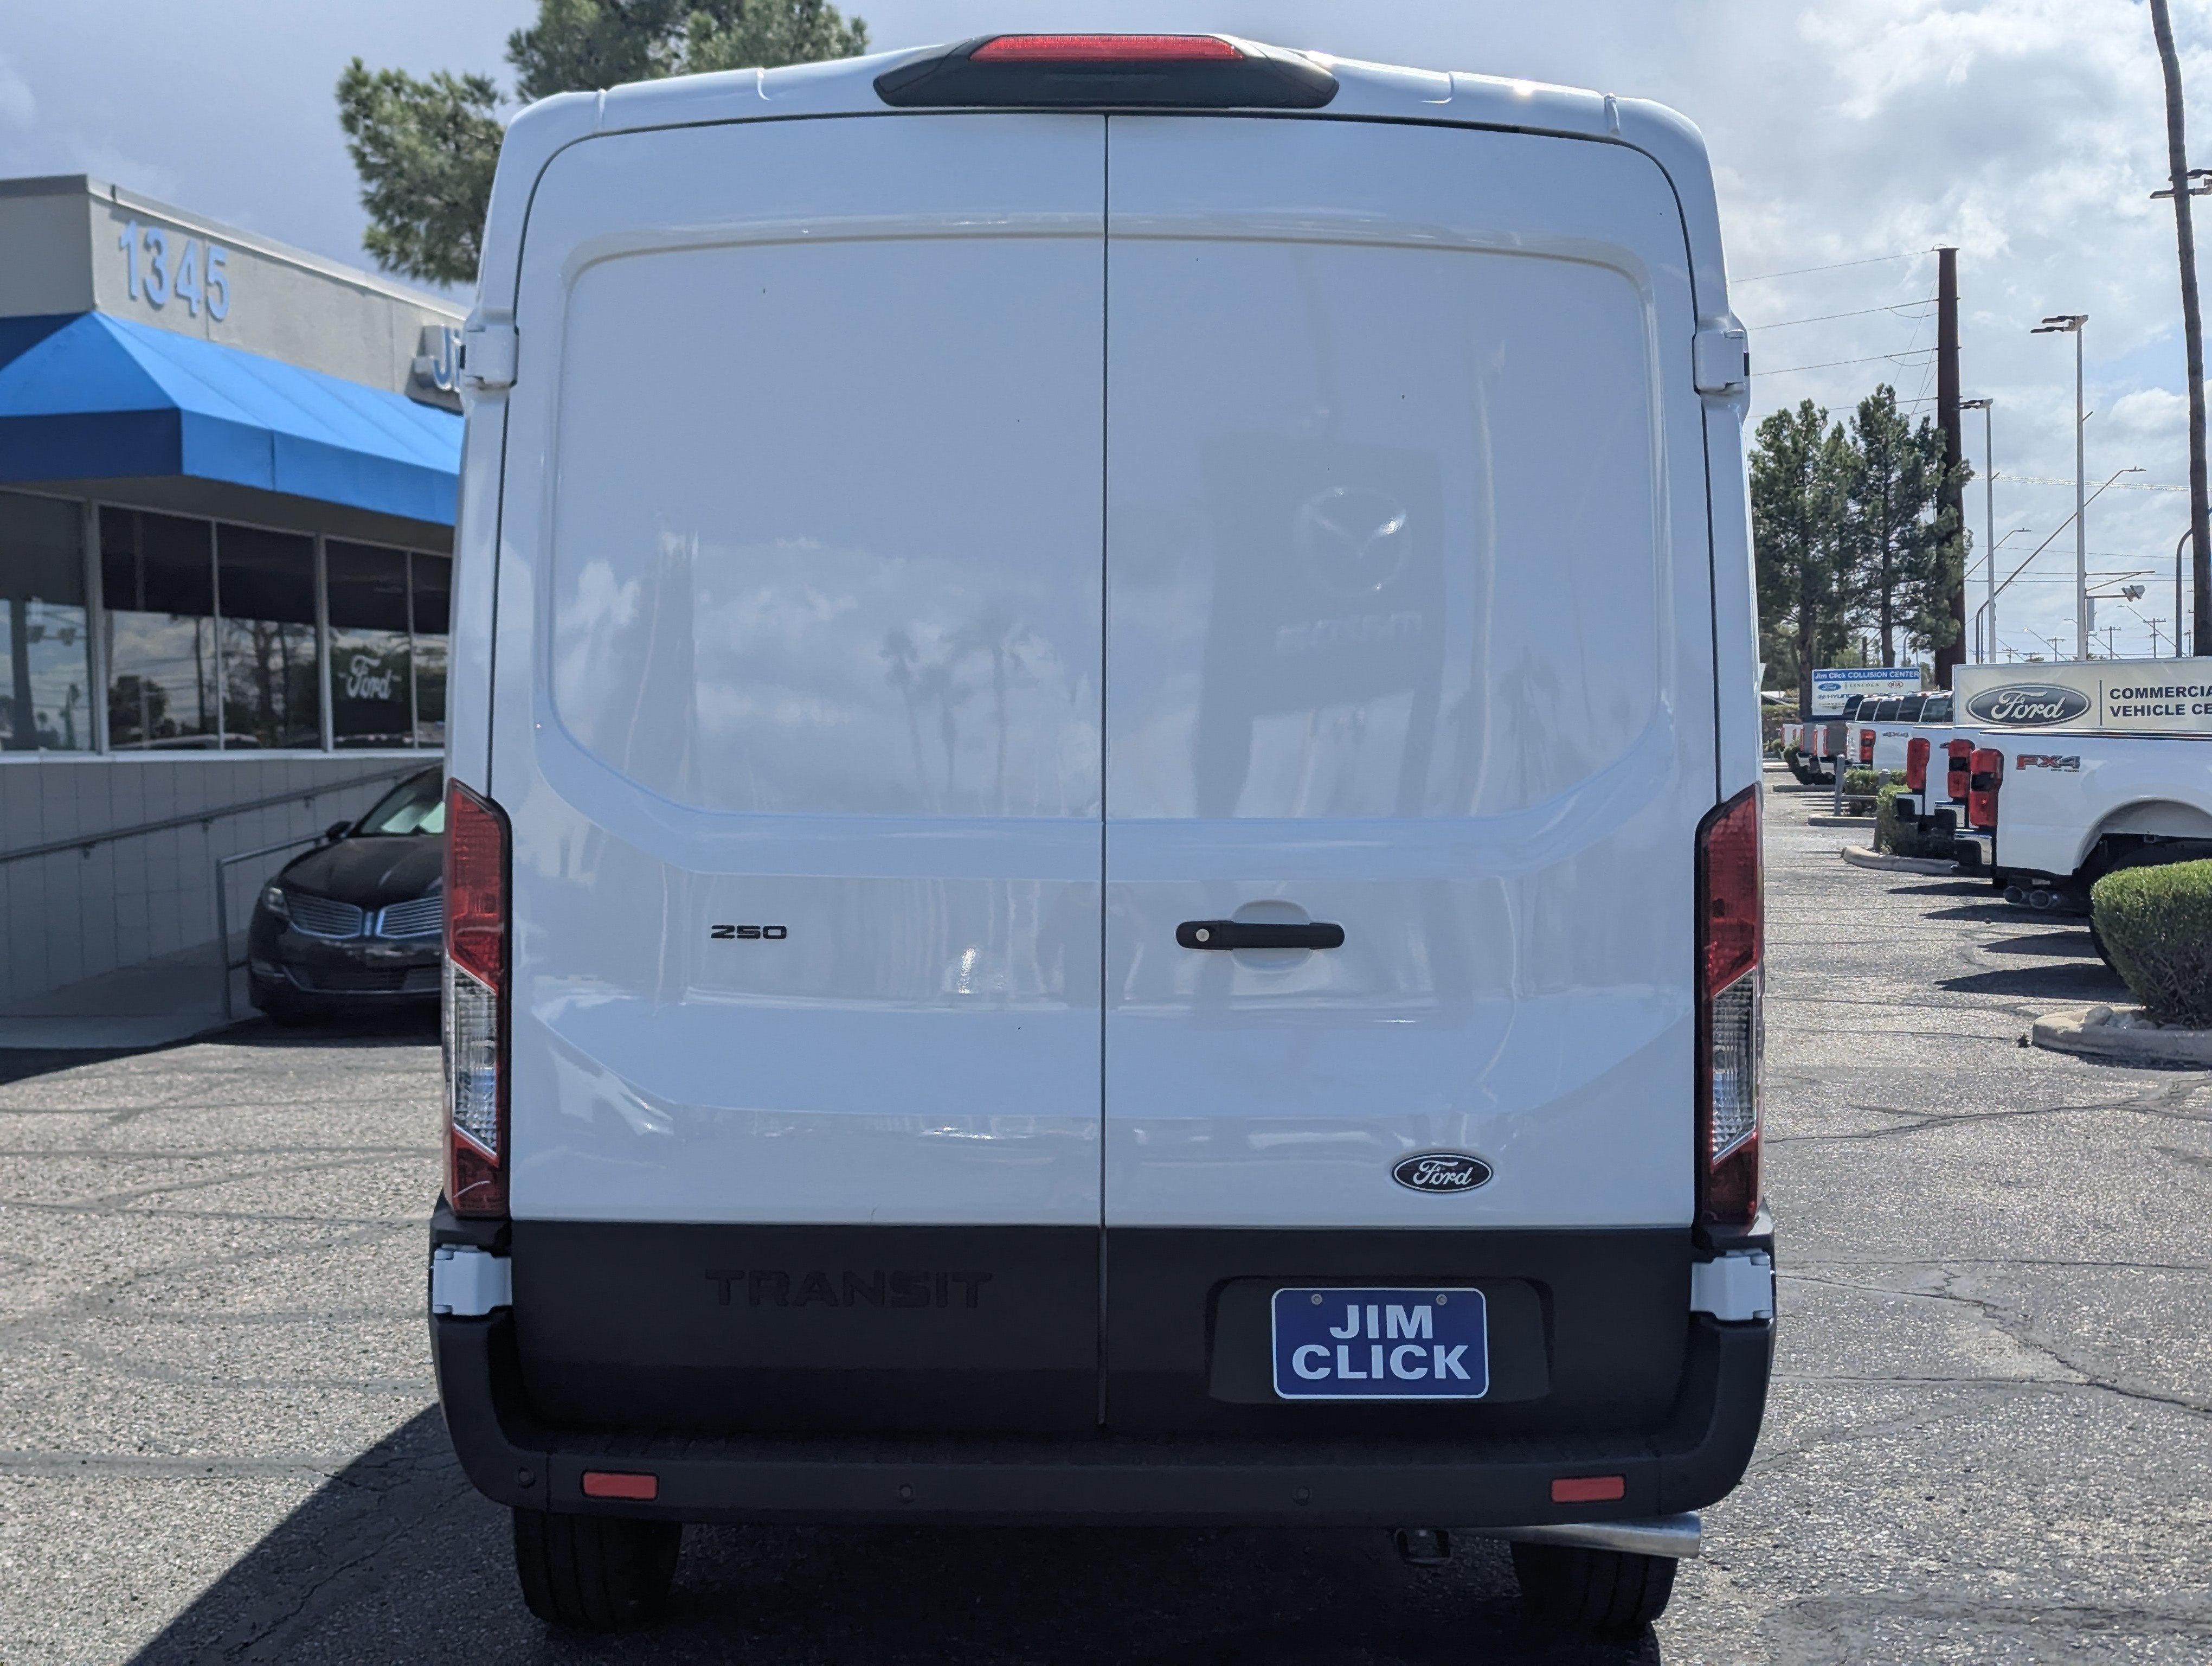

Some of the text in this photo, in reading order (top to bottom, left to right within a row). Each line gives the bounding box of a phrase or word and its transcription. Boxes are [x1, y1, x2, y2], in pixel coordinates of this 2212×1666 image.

[120, 220, 230, 319] 1345
[346, 654, 392, 699] Ford
[1991, 690, 2066, 719] Ford
[2110, 704, 2185, 717] VEHICLE
[2016, 754, 2080, 770] FX4
[711, 925, 787, 939] 250
[1413, 1160, 1474, 1185] Ford
[705, 1269, 993, 1308] TRANSIT
[1329, 1305, 1433, 1339] JIM
[1292, 1344, 1471, 1380] CLICK
